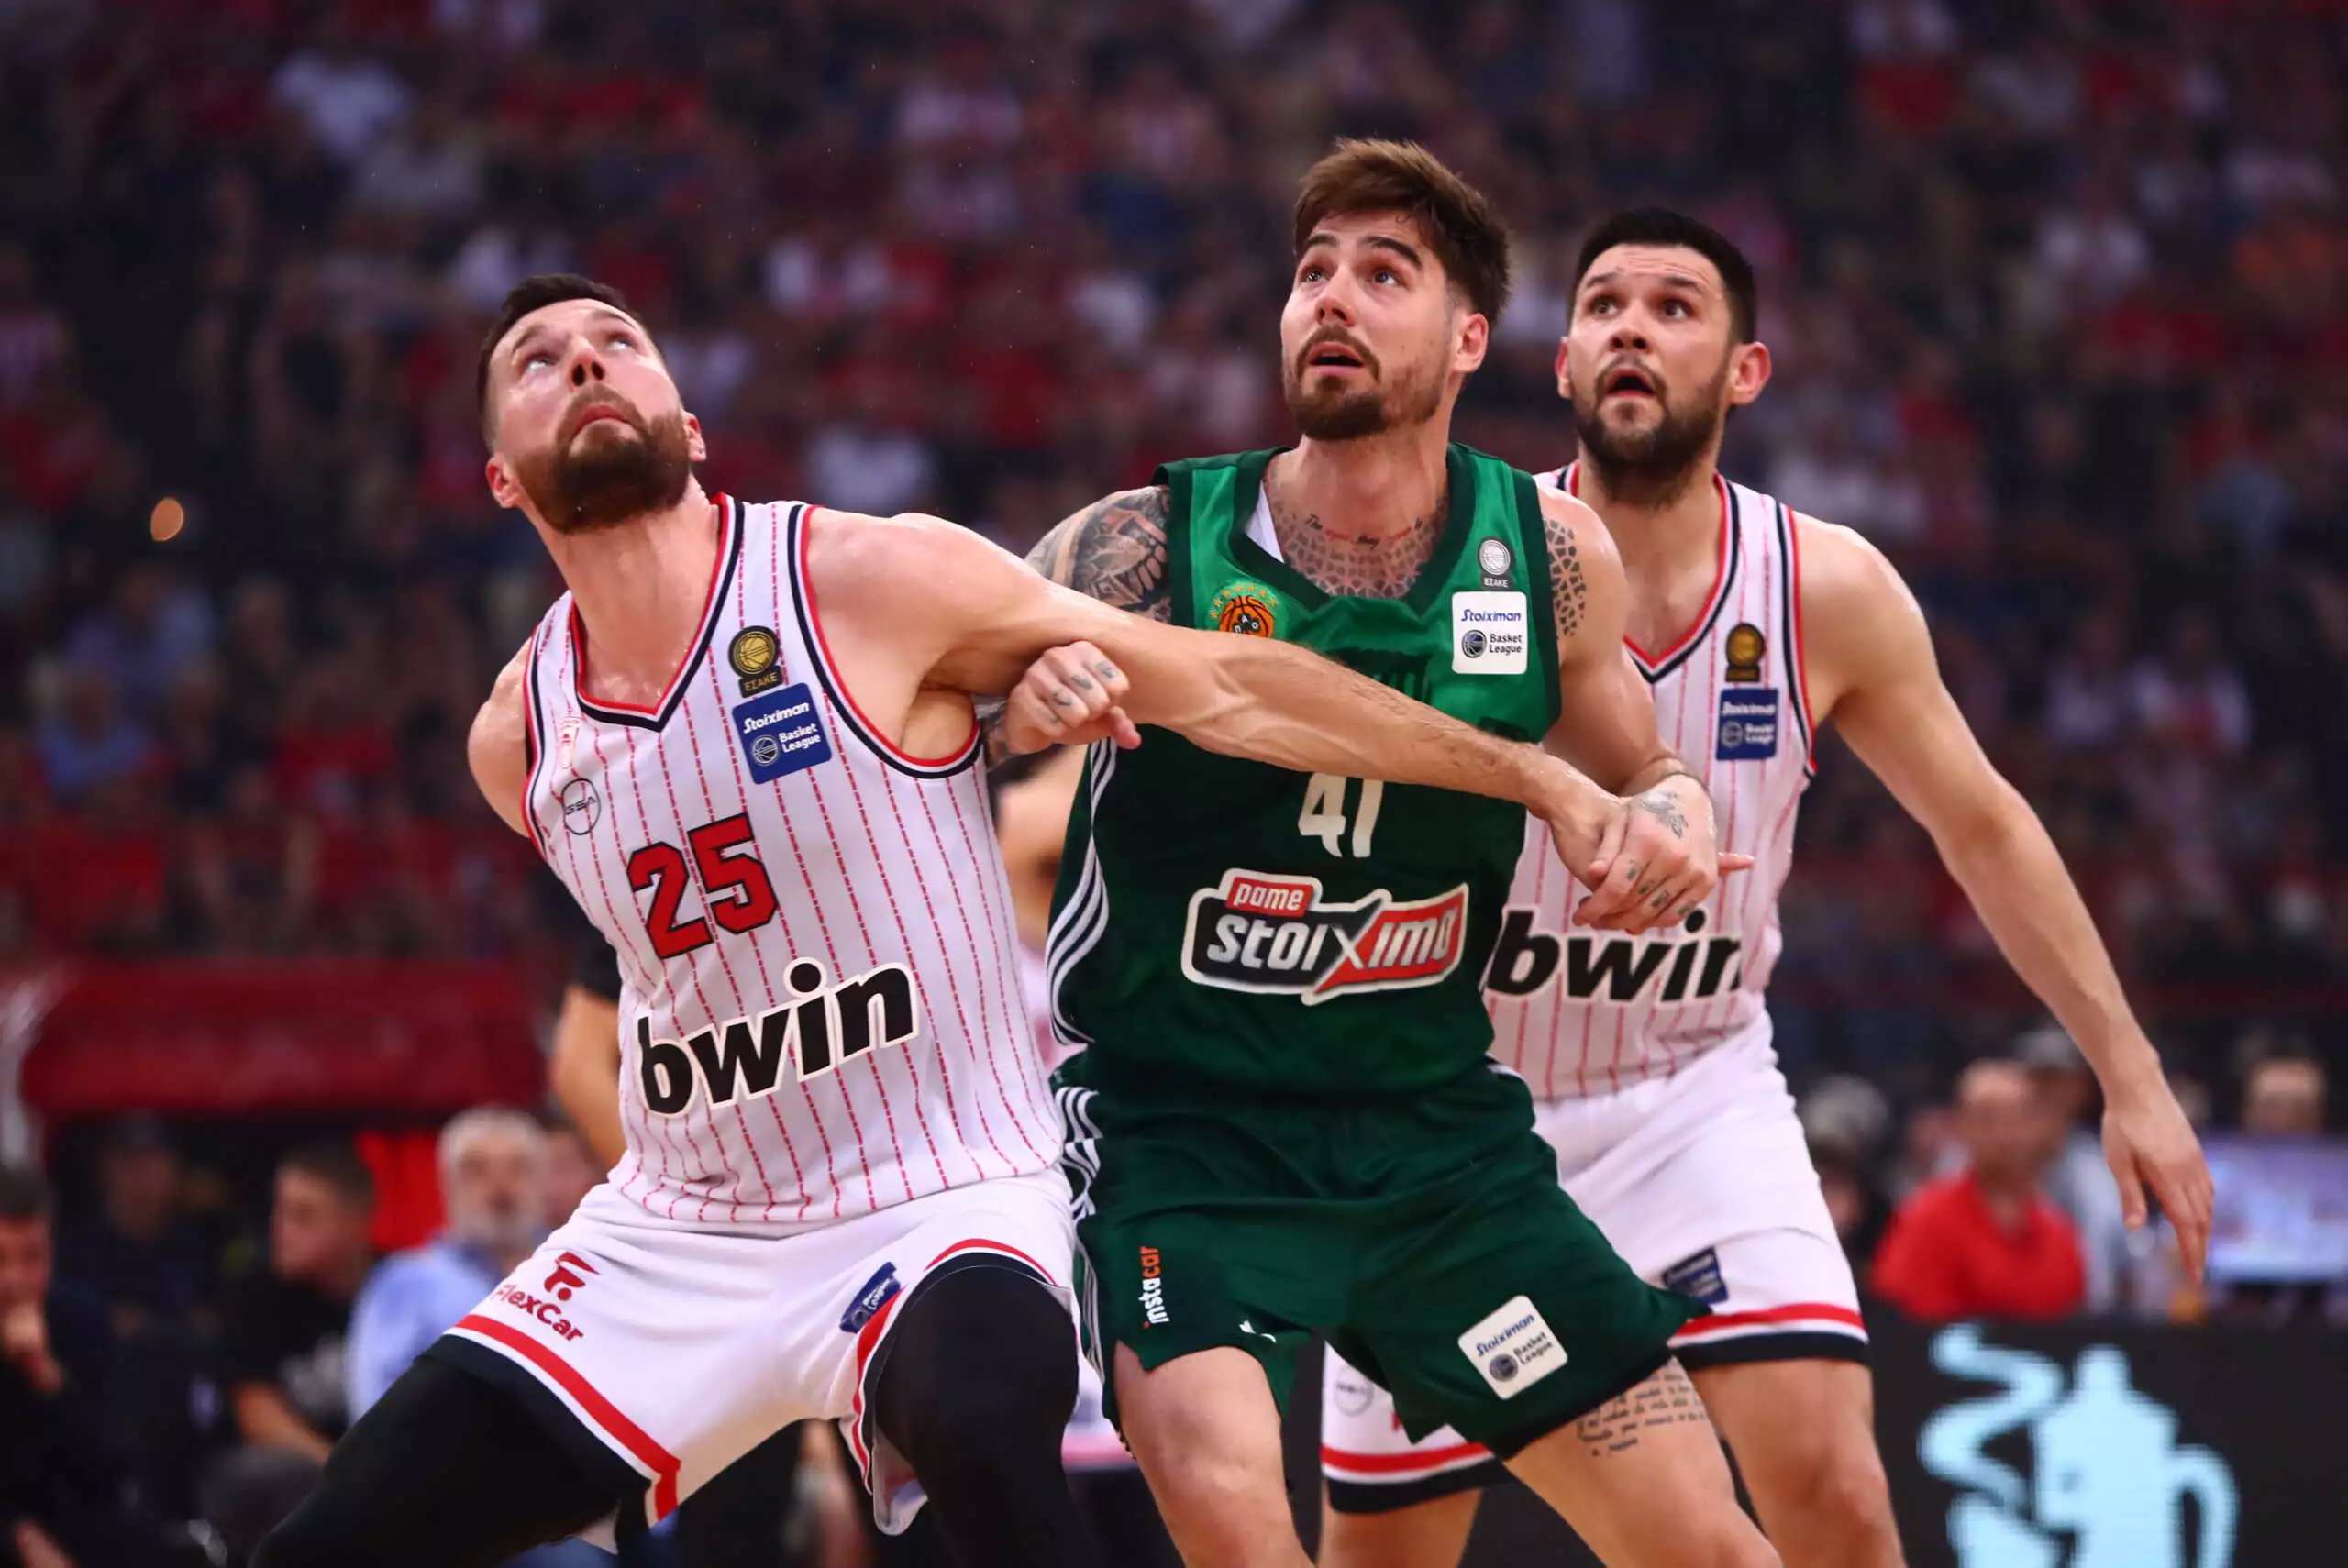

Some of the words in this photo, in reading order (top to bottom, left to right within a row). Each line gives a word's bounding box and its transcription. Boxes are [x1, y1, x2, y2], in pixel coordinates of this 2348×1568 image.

[1461, 608, 1522, 622] Stoiximan
[1490, 633, 1523, 643] Basket
[1490, 644, 1523, 656] League
[743, 701, 811, 734] Stoiximan
[778, 723, 819, 744] Basket
[781, 734, 822, 754] League
[626, 812, 780, 960] 25
[1232, 883, 1305, 911] pame
[637, 961, 916, 1116] bwin
[1138, 1246, 1171, 1329] instacar
[1476, 1314, 1535, 1357] Stoiximan
